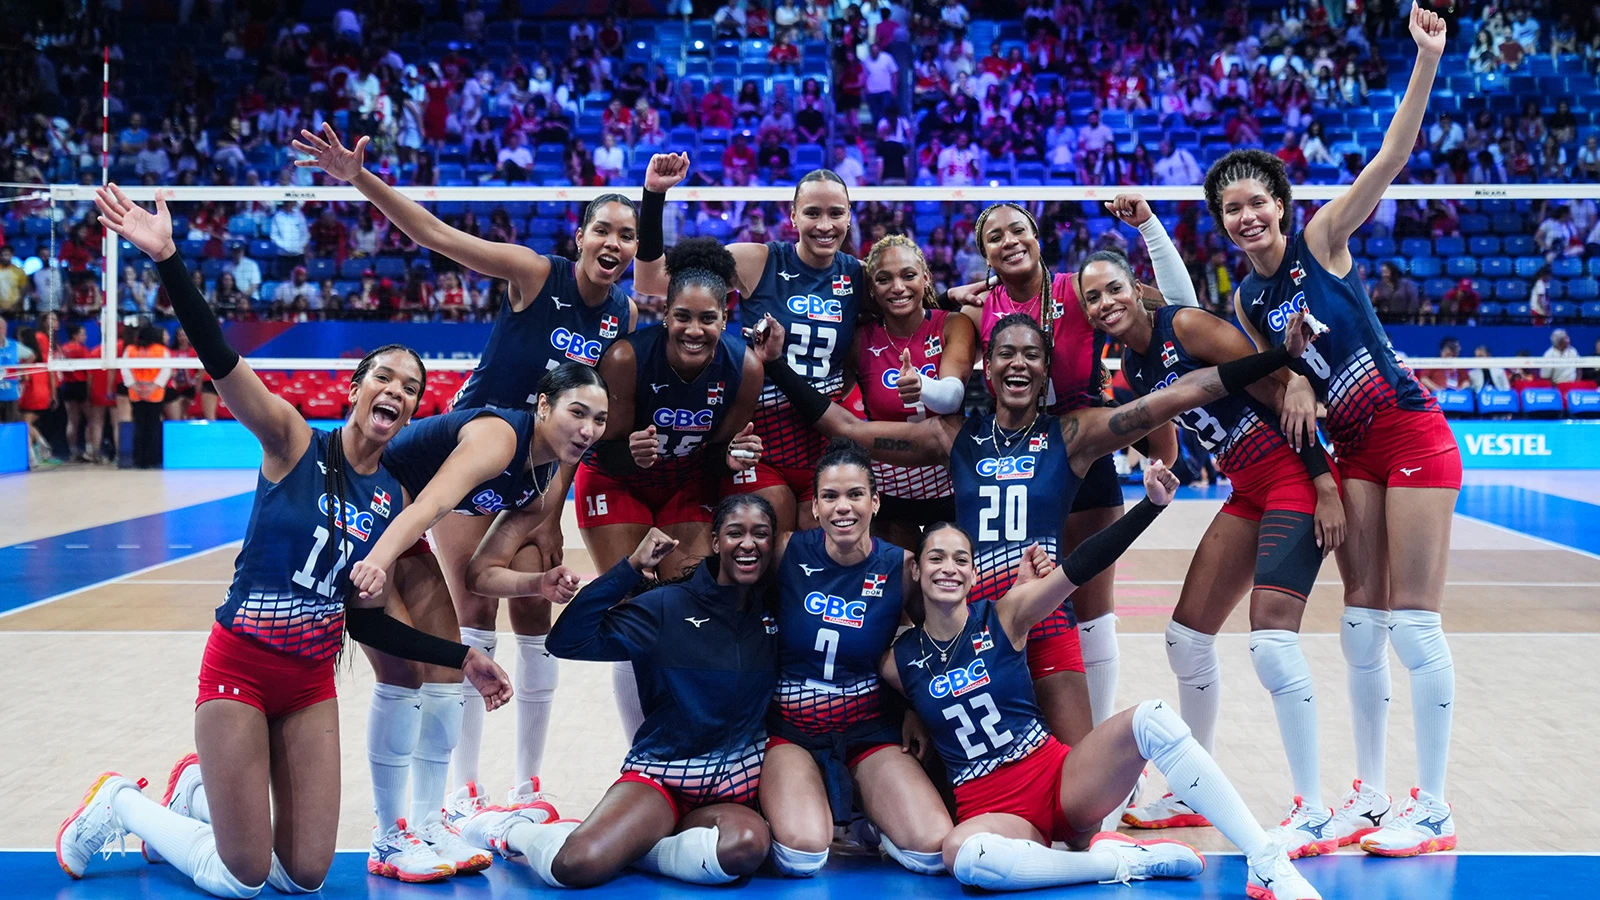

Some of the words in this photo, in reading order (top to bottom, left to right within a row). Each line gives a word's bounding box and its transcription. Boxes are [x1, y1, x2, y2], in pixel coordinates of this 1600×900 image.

[787, 294, 842, 316] GBC
[550, 327, 602, 361] GBC
[787, 322, 837, 378] 23
[881, 363, 939, 390] GC
[653, 407, 713, 428] GBC
[1464, 433, 1552, 456] VESTEL
[976, 456, 1036, 477] GBC
[318, 493, 374, 535] GBC
[586, 493, 608, 516] 16
[978, 484, 1028, 542] 20
[291, 525, 354, 598] 11
[804, 591, 867, 621] GBC
[814, 627, 840, 681] 7
[929, 658, 989, 698] GBC
[941, 692, 1014, 760] 22
